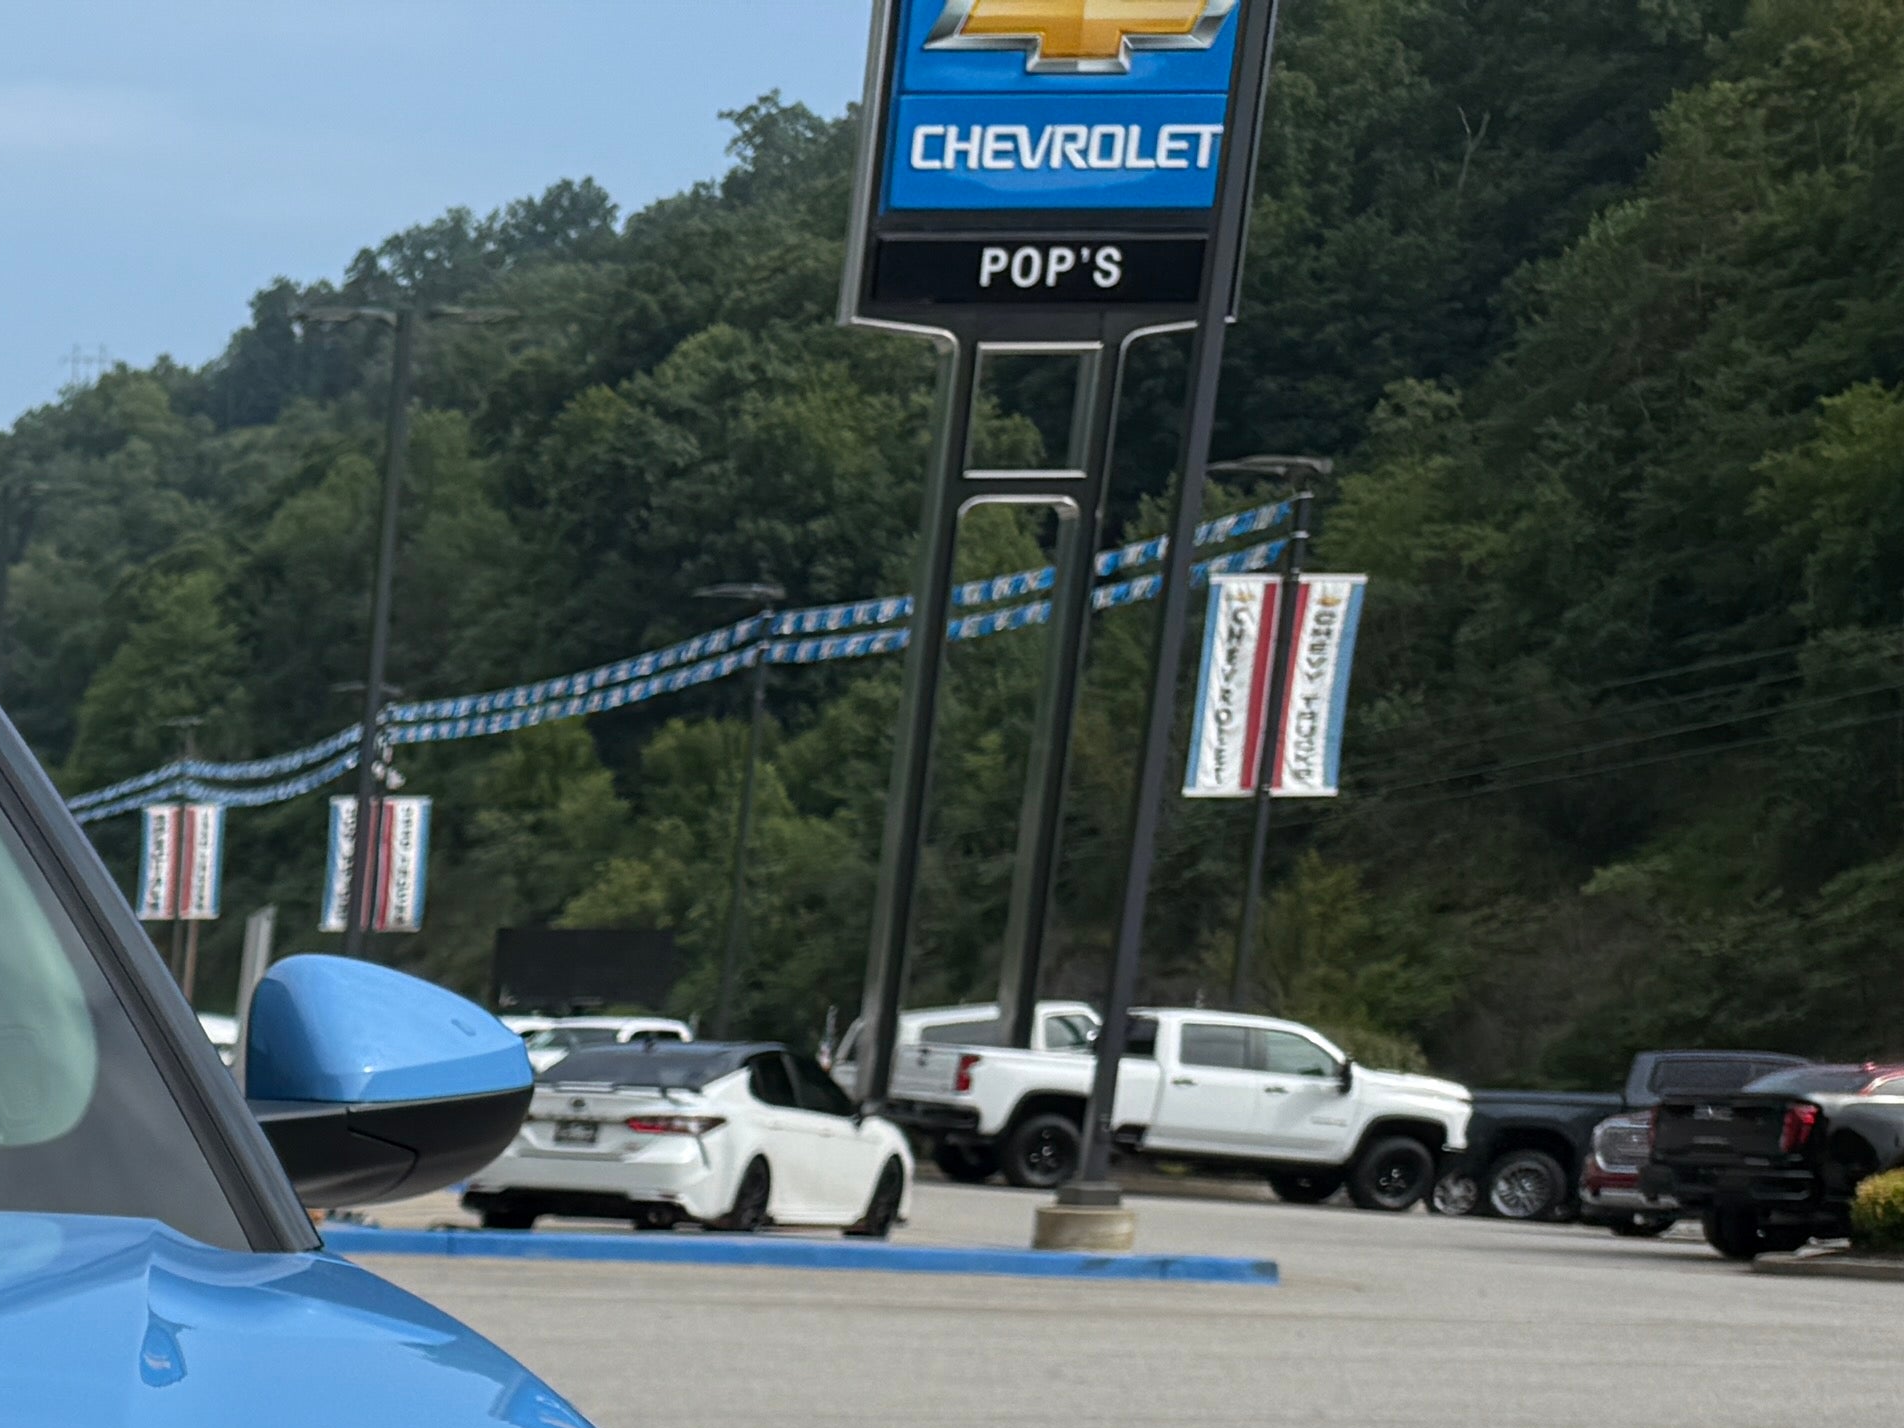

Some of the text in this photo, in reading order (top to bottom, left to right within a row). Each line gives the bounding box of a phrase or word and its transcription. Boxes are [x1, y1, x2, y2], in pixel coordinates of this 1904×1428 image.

[910, 123, 1224, 170] CHEVROLET
[978, 245, 1124, 288] POP'S
[1306, 610, 1337, 681] CHEVY
[1214, 607, 1255, 785] CHEVROLET
